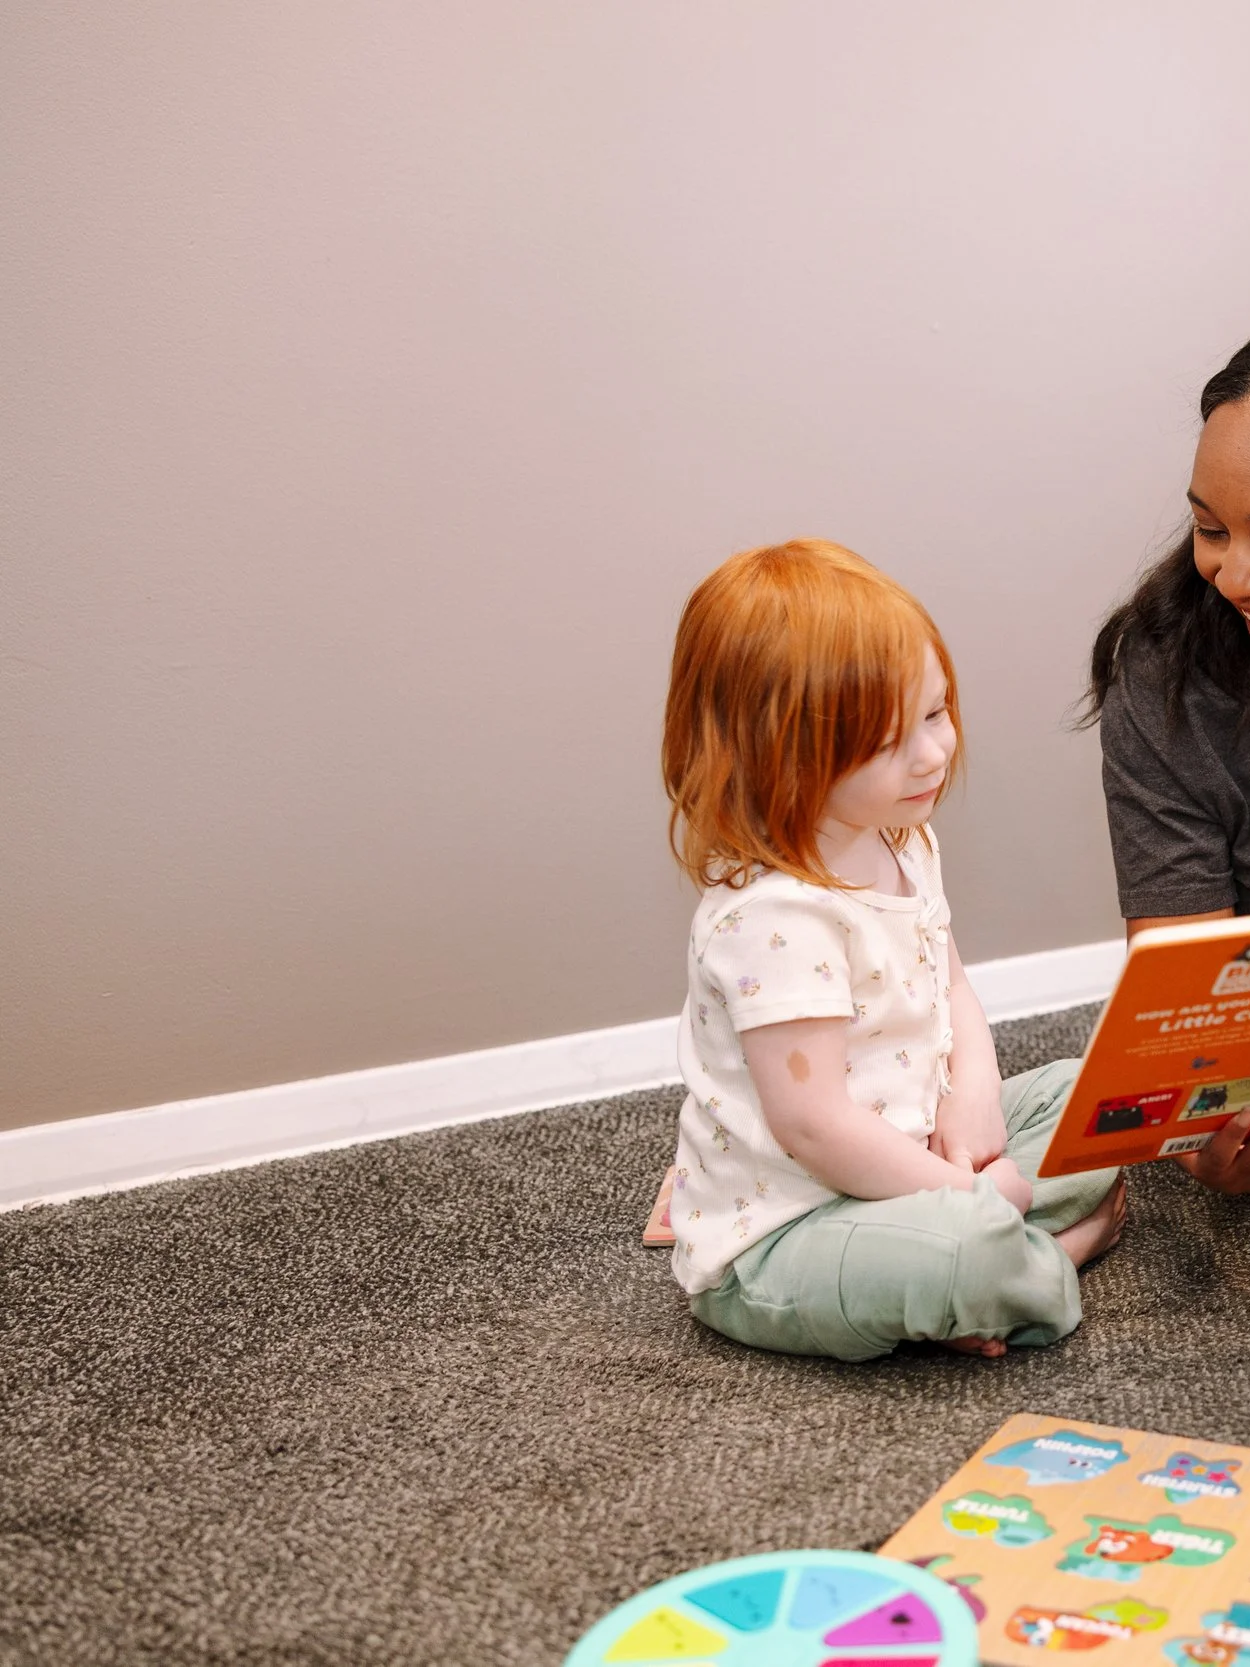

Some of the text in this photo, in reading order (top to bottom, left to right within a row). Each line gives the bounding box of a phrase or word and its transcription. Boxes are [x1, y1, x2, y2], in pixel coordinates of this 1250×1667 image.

[1158, 1010, 1227, 1034] Little
[1033, 1437, 1119, 1461] DOLPHIN
[1141, 1473, 1238, 1498] STARFISH
[952, 1498, 1031, 1523] TURTLE
[1150, 1529, 1224, 1555] TIGER
